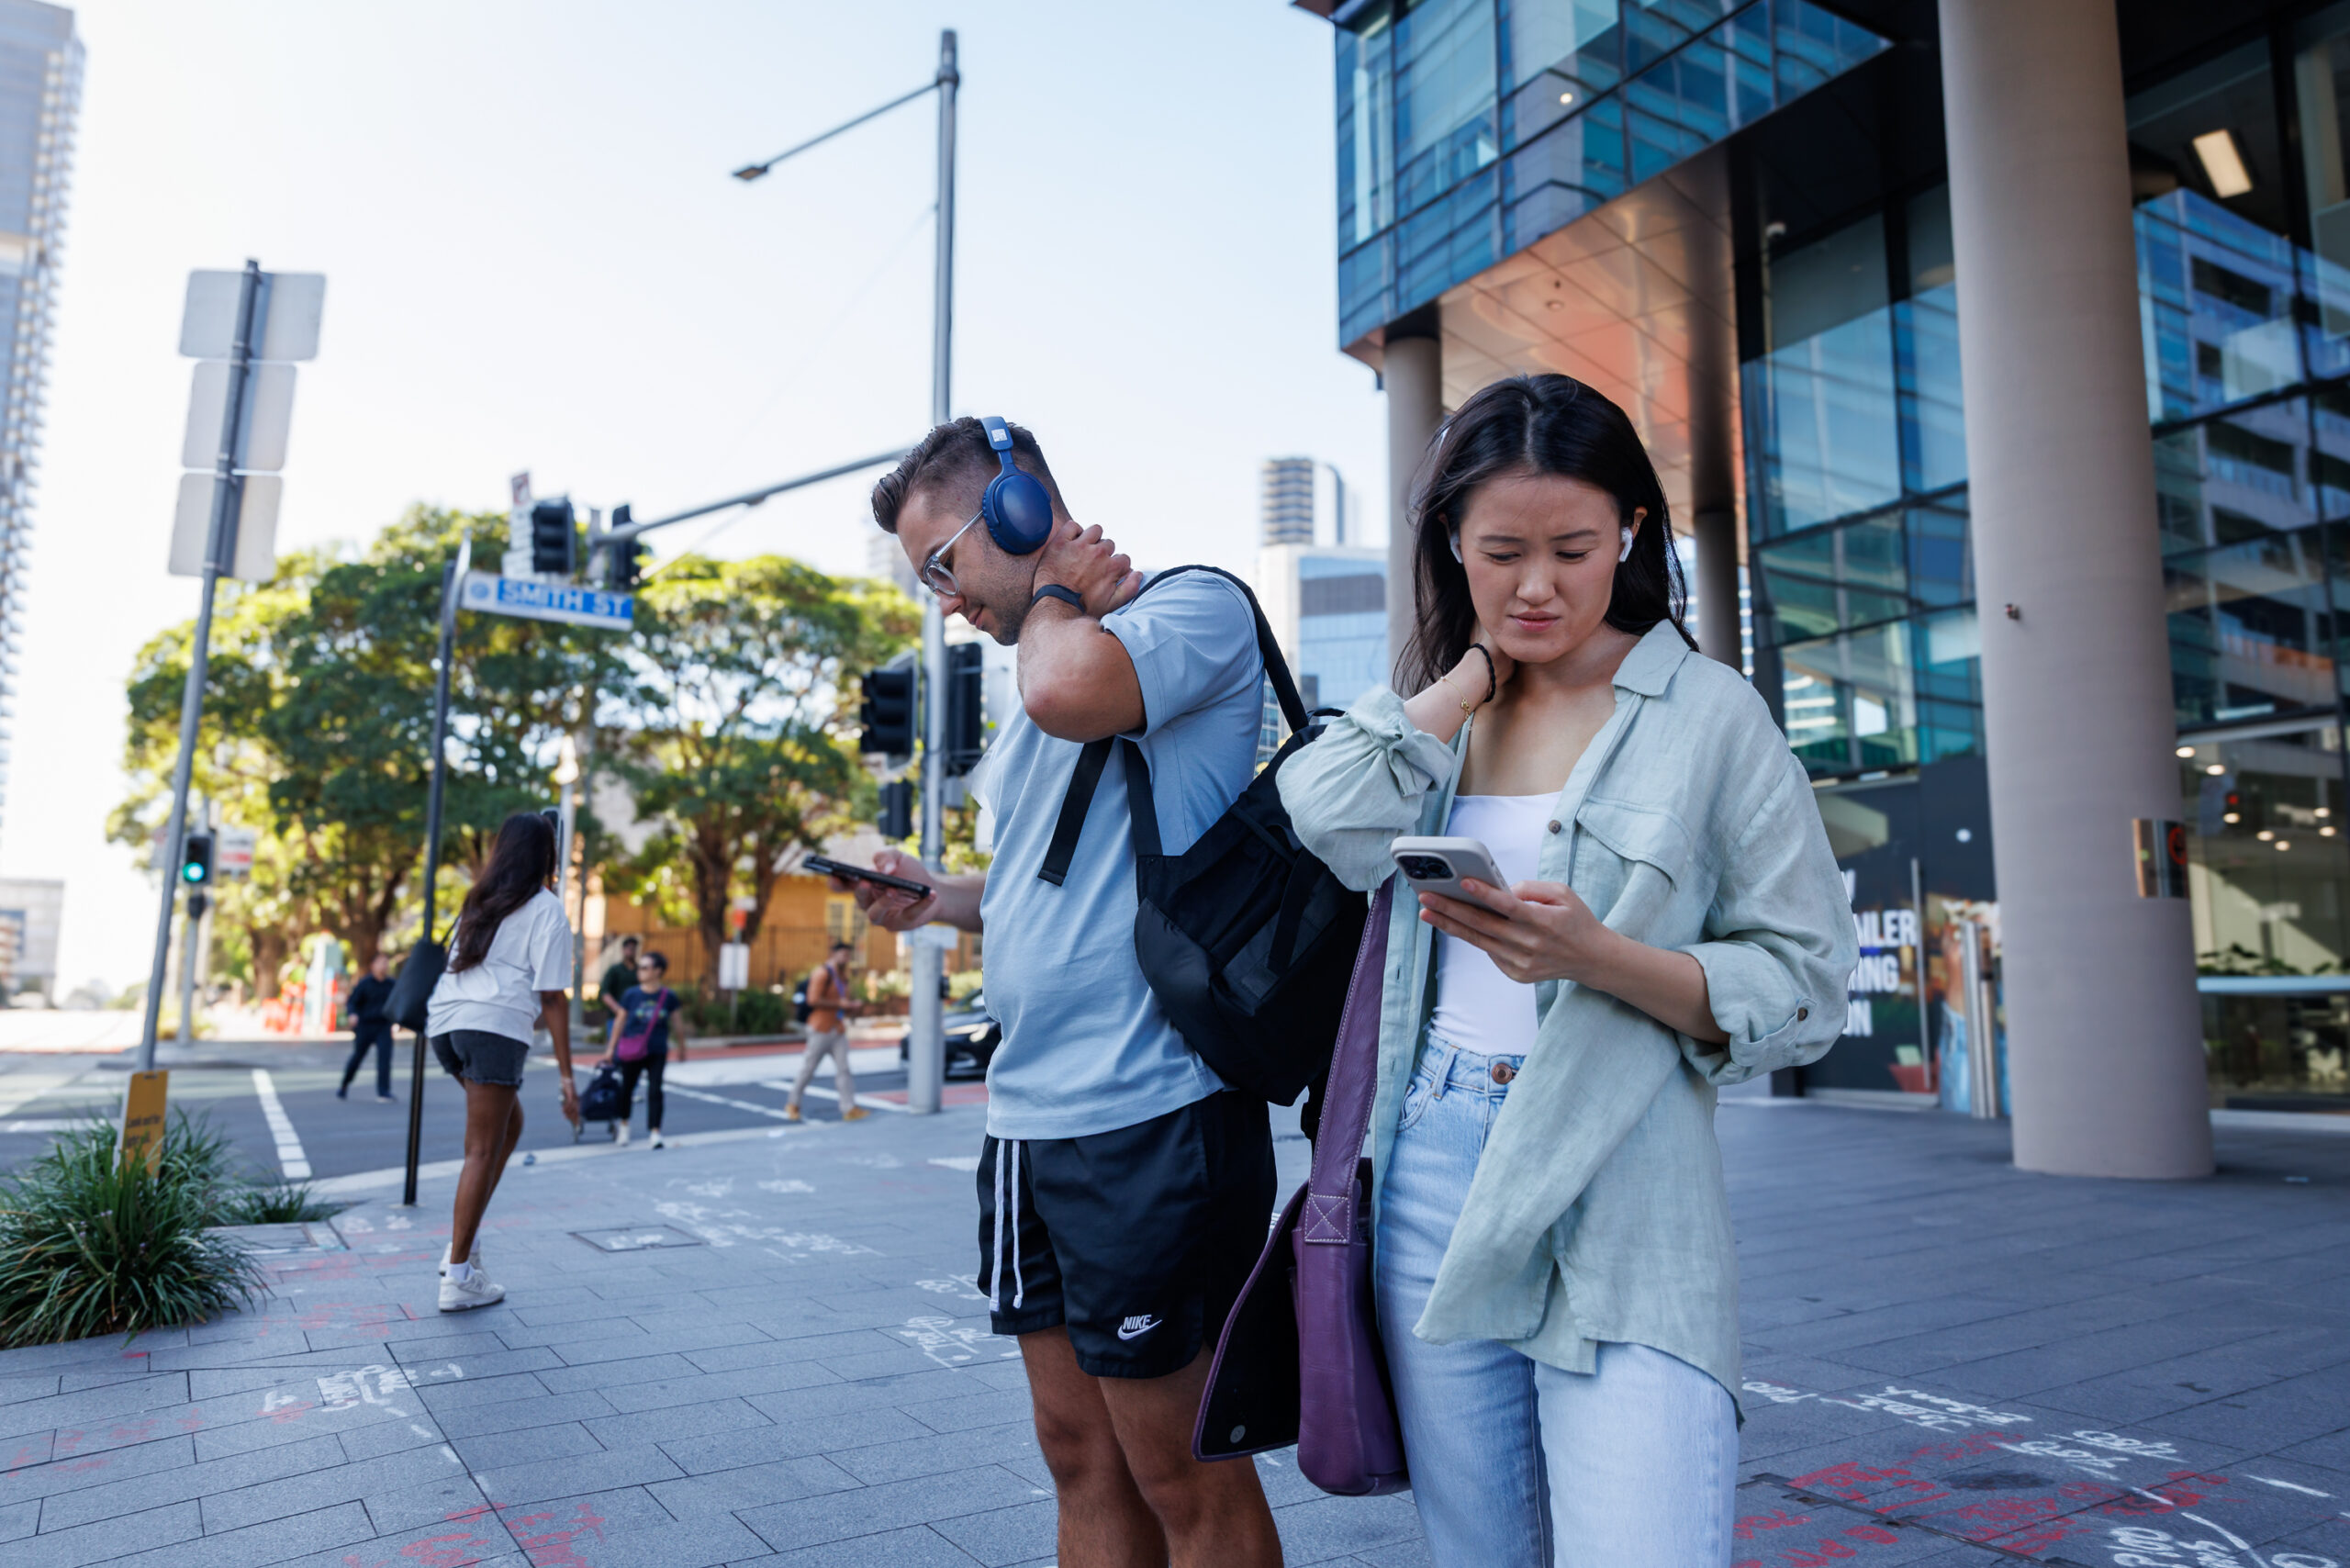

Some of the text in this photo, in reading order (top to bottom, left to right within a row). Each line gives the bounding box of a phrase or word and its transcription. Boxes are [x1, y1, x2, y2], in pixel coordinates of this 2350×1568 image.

[503, 578, 629, 617] SMITH ST
[1123, 1315, 1152, 1329] NIKE
